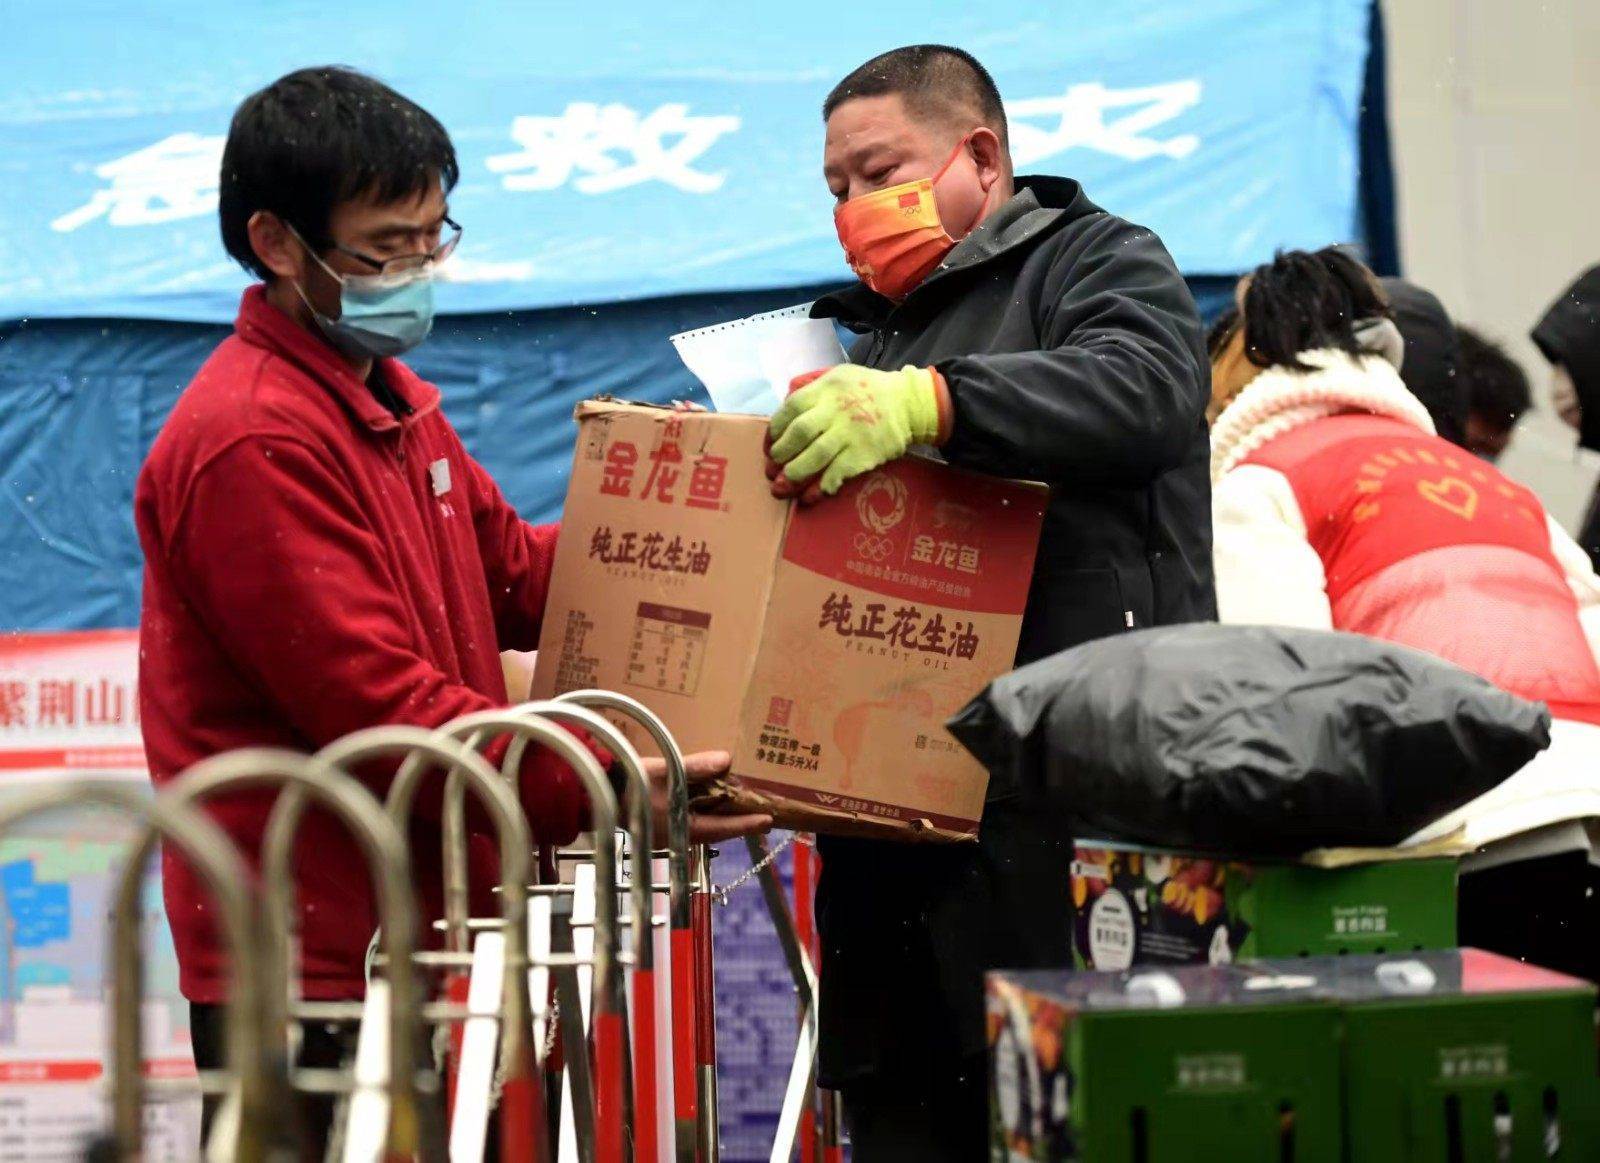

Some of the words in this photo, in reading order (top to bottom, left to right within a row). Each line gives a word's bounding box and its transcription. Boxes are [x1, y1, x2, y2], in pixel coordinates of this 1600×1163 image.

[600, 441, 728, 511] 金龙鱼
[588, 526, 711, 576] 纯正花生油
[911, 535, 979, 574] 金龙鱼
[818, 592, 979, 660] 纯正花生油
[845, 640, 910, 661] PEANUT
[923, 657, 949, 670] OIL
[0, 678, 140, 728] 紫荆山
